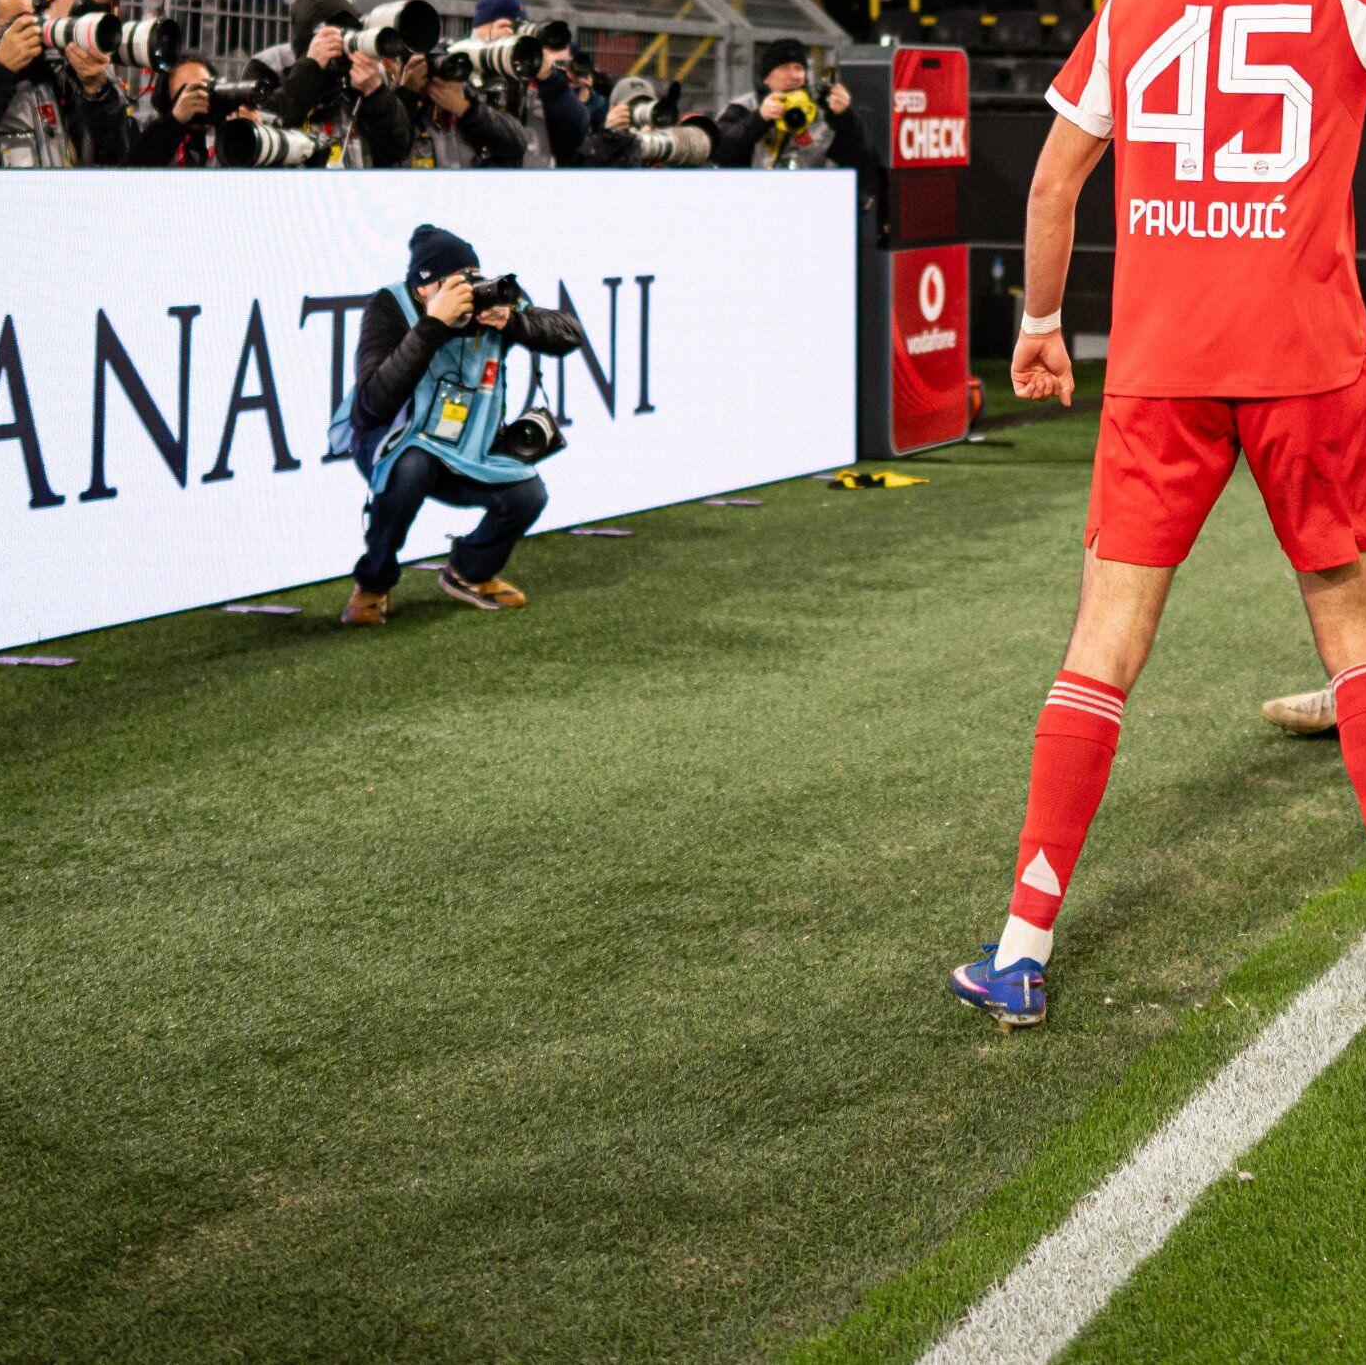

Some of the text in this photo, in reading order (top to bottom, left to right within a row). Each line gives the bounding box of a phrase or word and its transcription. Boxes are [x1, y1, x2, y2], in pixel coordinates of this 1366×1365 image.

[893, 89, 927, 114] SPEED
[1125, 4, 1313, 183] 45
[899, 117, 967, 161] CHECK
[1129, 194, 1287, 239] PAVLOVIĆ
[906, 328, 957, 355] vodafone
